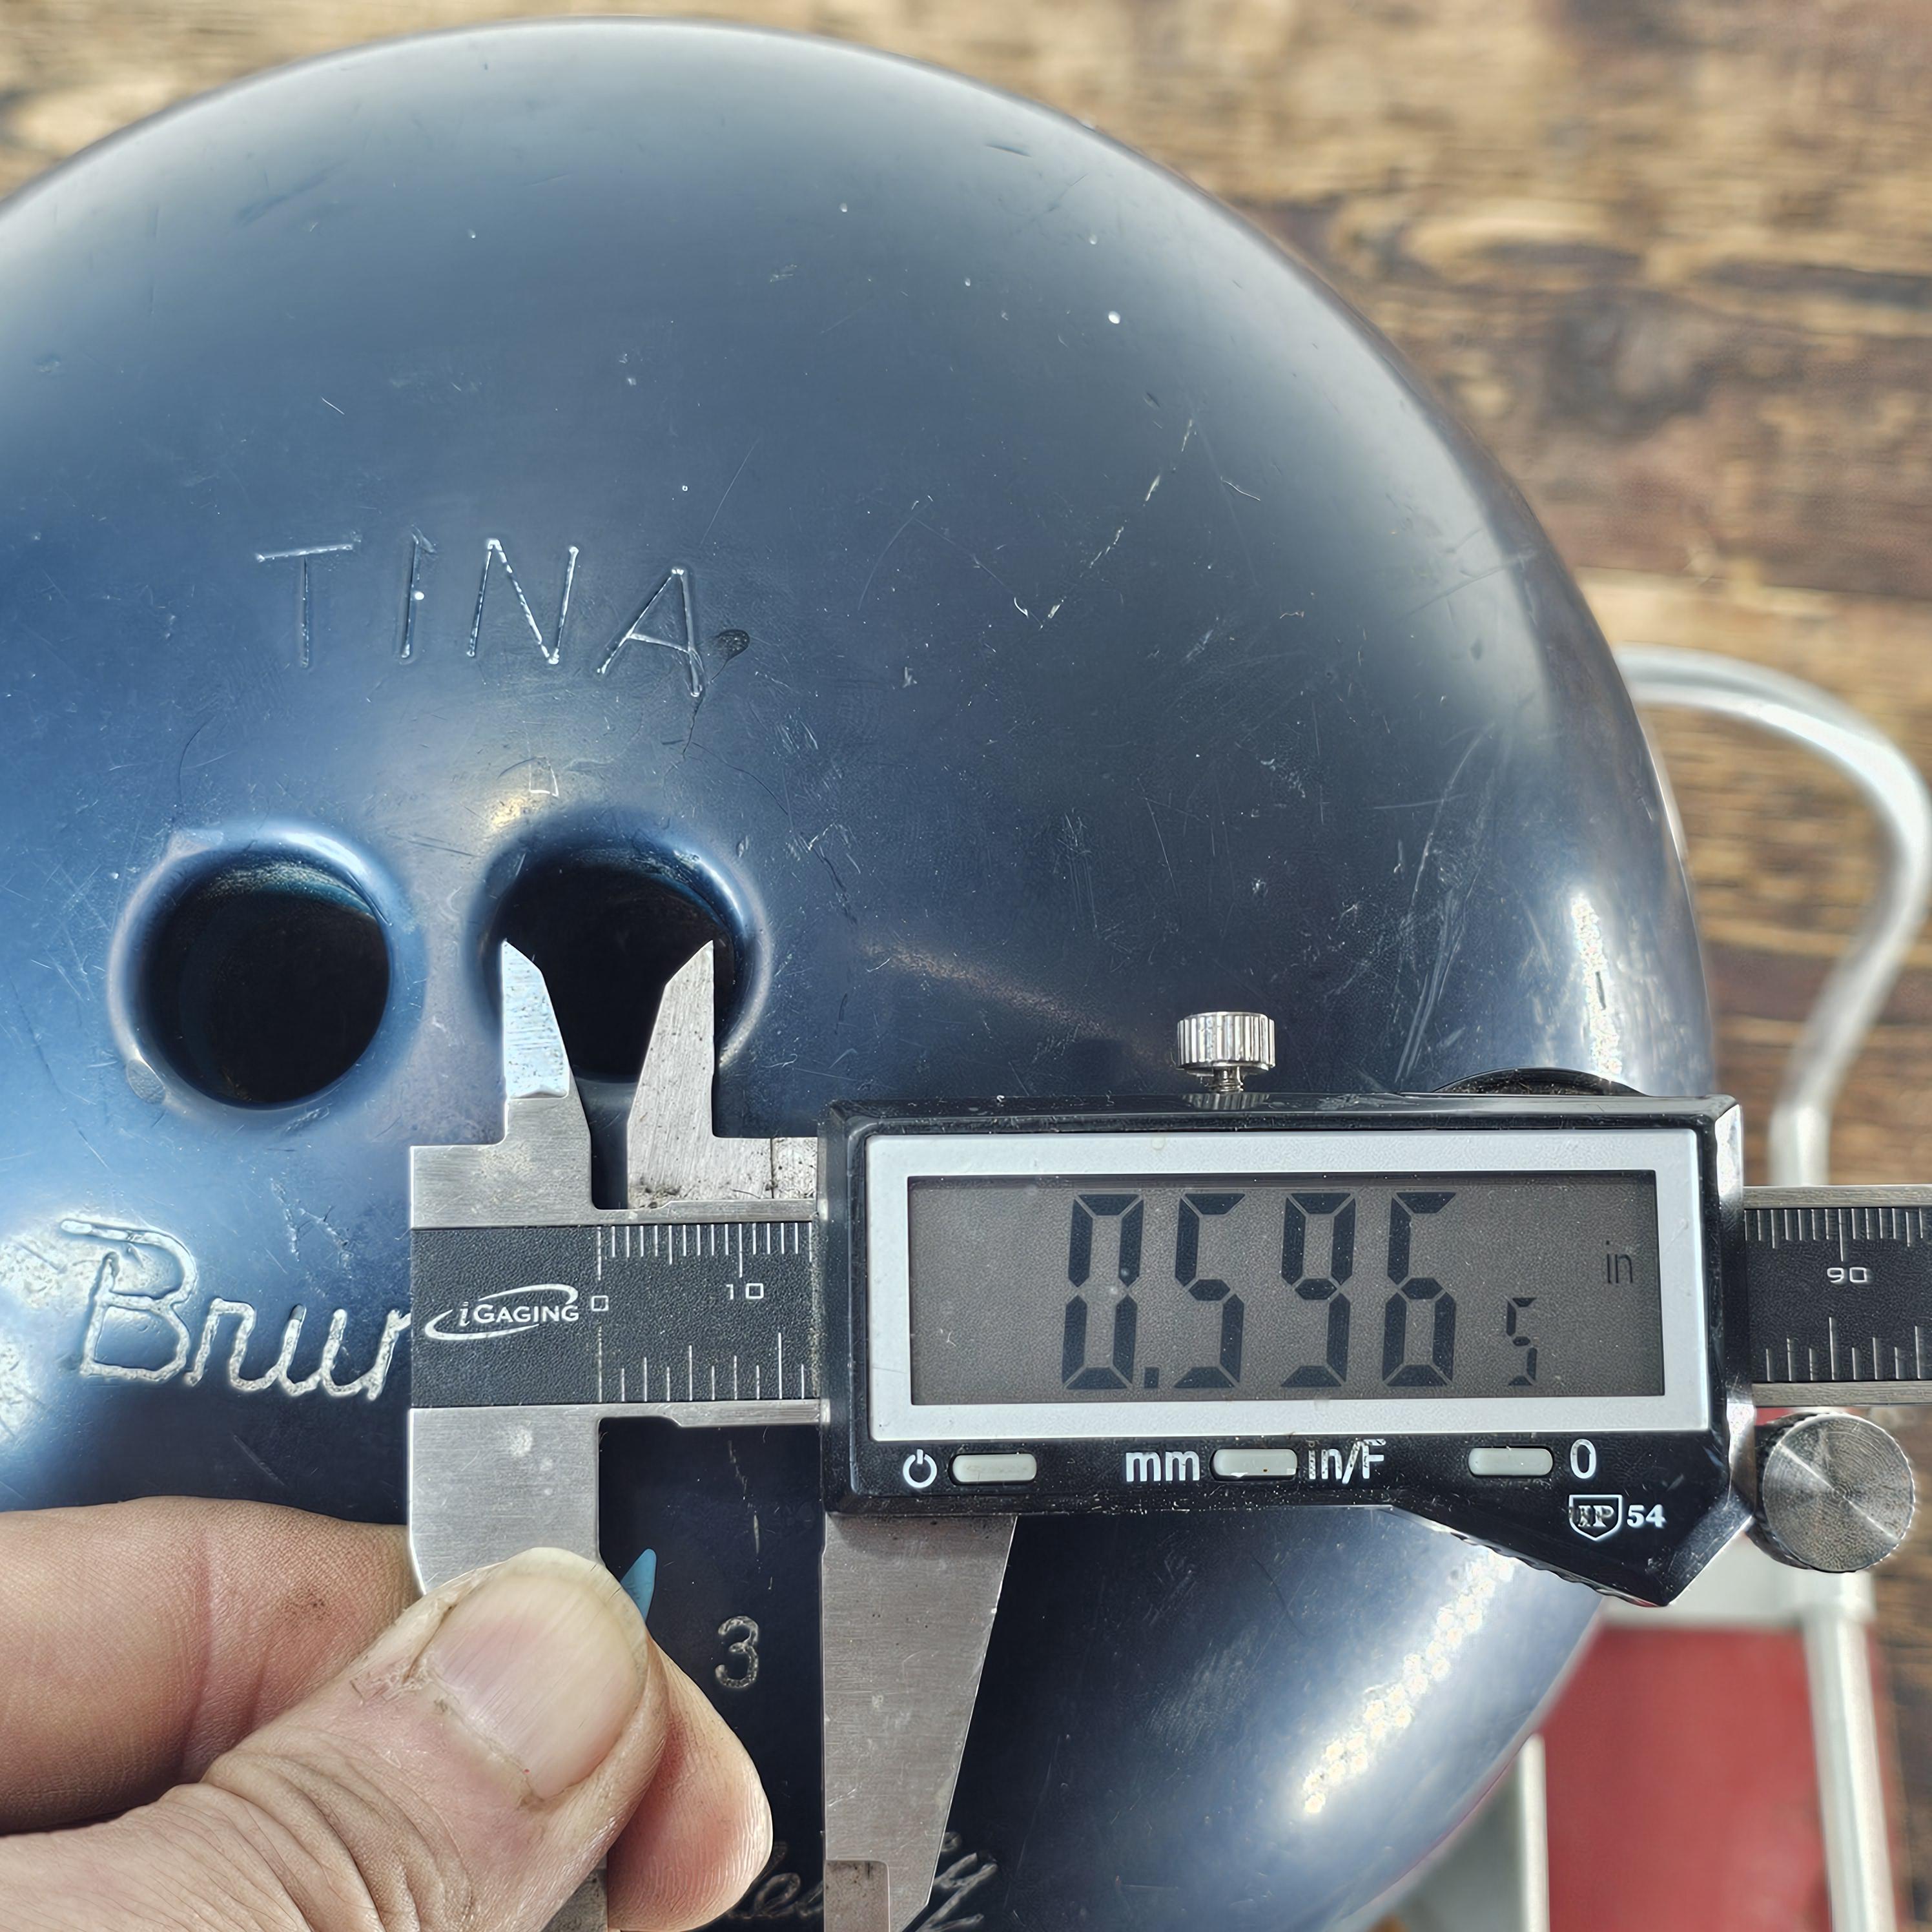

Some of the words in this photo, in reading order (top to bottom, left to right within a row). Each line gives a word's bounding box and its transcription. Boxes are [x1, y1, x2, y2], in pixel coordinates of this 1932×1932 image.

[255, 528, 708, 699] TINA
[1605, 1239, 1634, 1284] in
[1827, 1267, 1867, 1283] 90
[726, 1282, 765, 1300] 10
[458, 1300, 580, 1327] iGAGING
[1125, 1450, 1201, 1483] mm
[1307, 1437, 1386, 1484] in/F
[1570, 1438, 1597, 1479] 0
[1627, 1503, 1667, 1529] 54
[715, 1616, 760, 1689] 3
